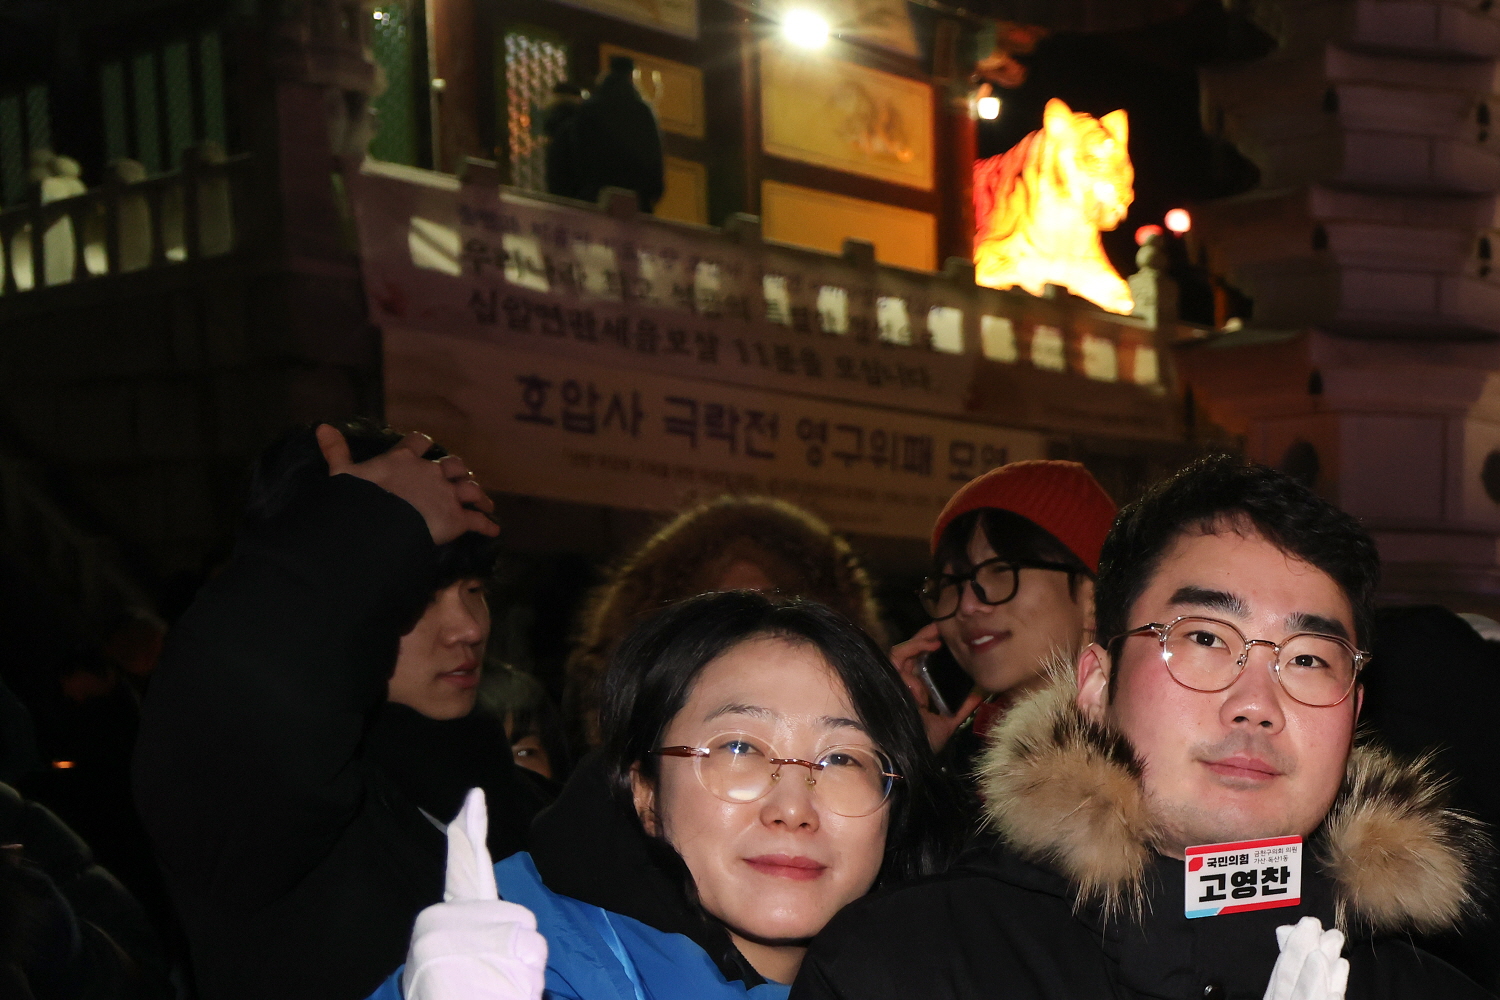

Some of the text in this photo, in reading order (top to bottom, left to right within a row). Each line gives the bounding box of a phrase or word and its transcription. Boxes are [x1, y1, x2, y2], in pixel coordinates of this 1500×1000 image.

[514, 374, 644, 439] 호압사
[663, 395, 780, 460] 극락전
[795, 416, 936, 478] 영구위패
[1206, 853, 1249, 868] 국민의힘
[1253, 846, 1298, 858] 금천구의회 의원
[1198, 865, 1291, 903] 고영찬
